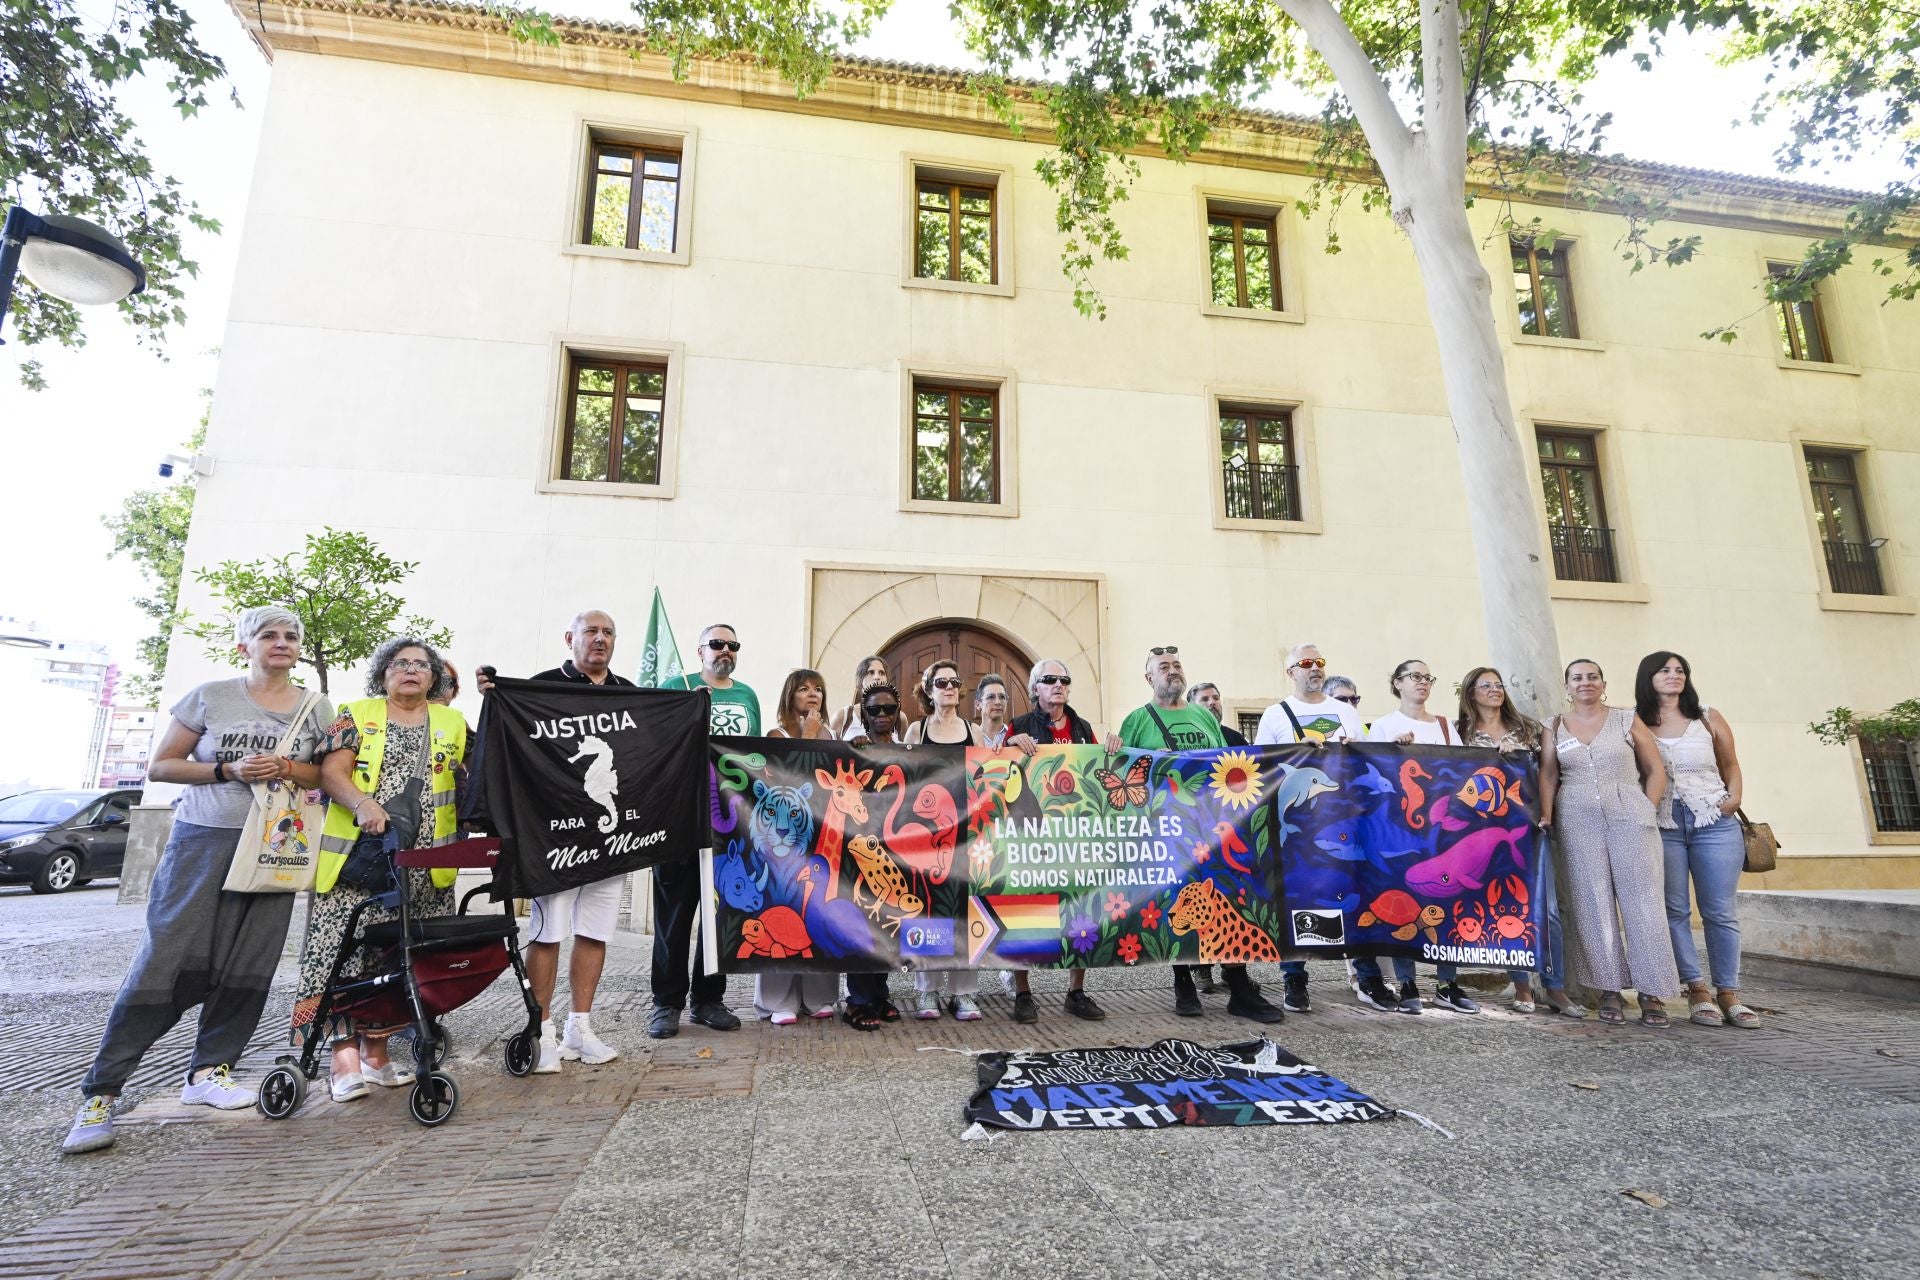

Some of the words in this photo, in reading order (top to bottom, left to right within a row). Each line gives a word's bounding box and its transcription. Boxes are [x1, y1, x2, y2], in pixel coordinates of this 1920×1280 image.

[529, 710, 638, 740] JUSTICIA
[220, 733, 301, 752] WANDR
[550, 817, 587, 831] PARA
[625, 808, 641, 821] EL
[994, 817, 1018, 839] LA
[1023, 815, 1153, 838] NATURALEZA
[1158, 815, 1183, 837] ES
[257, 853, 310, 866] Chrysallis
[546, 845, 601, 871] Mar
[604, 829, 667, 857] Menor
[1007, 841, 1174, 864] BIODIVERSIDAD.
[1009, 868, 1069, 888] SOMOS
[1074, 866, 1182, 887] NATURALEZA.
[1423, 943, 1536, 966] SOSMARMENOR.ORG
[988, 1083, 1138, 1111] MAR
[1132, 1075, 1373, 1105] MENOR
